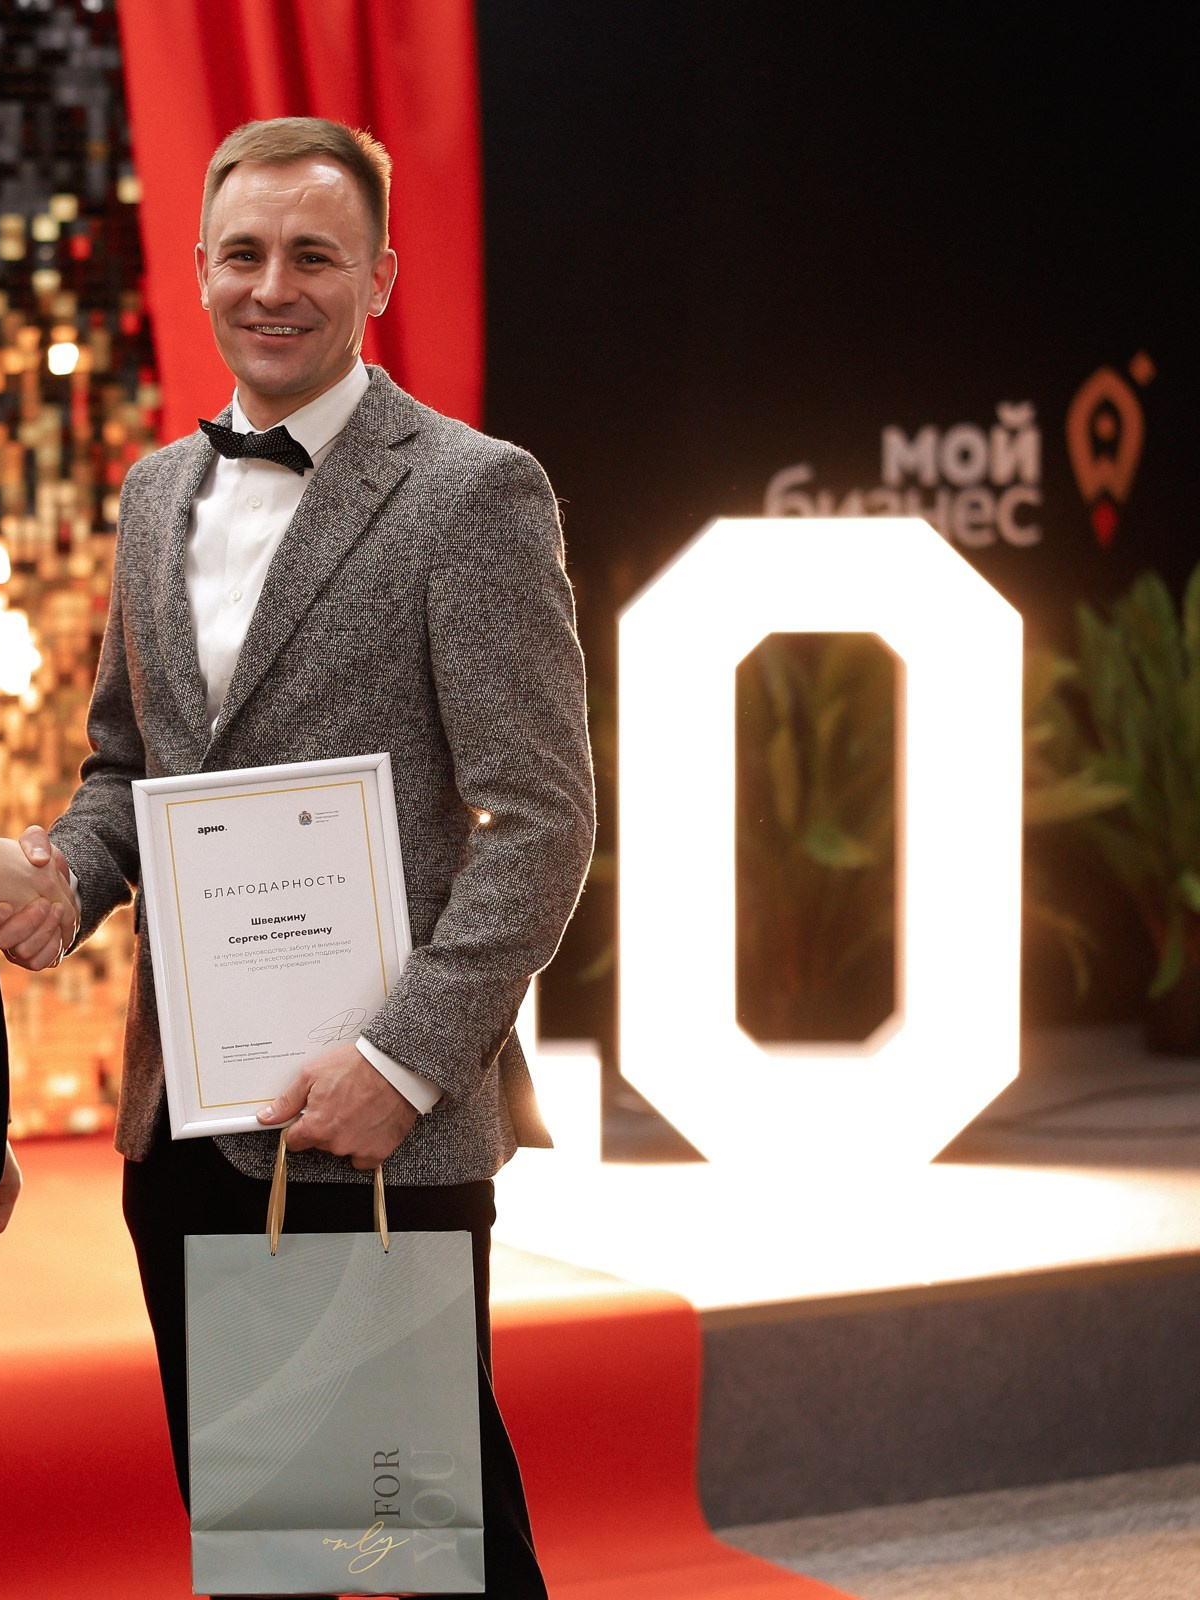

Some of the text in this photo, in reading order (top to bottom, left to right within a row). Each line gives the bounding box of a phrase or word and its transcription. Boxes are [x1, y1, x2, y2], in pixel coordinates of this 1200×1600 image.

[881, 402, 1041, 485] мой
[203, 874, 347, 899] БЛАГОДАРНОСТЬ
[228, 926, 333, 944] Сергею Сергеевичу
[250, 913, 307, 926] Шведкину
[373, 1448, 400, 1518] FOR
[410, 1446, 458, 1565] YOU
[322, 1520, 410, 1574] only
